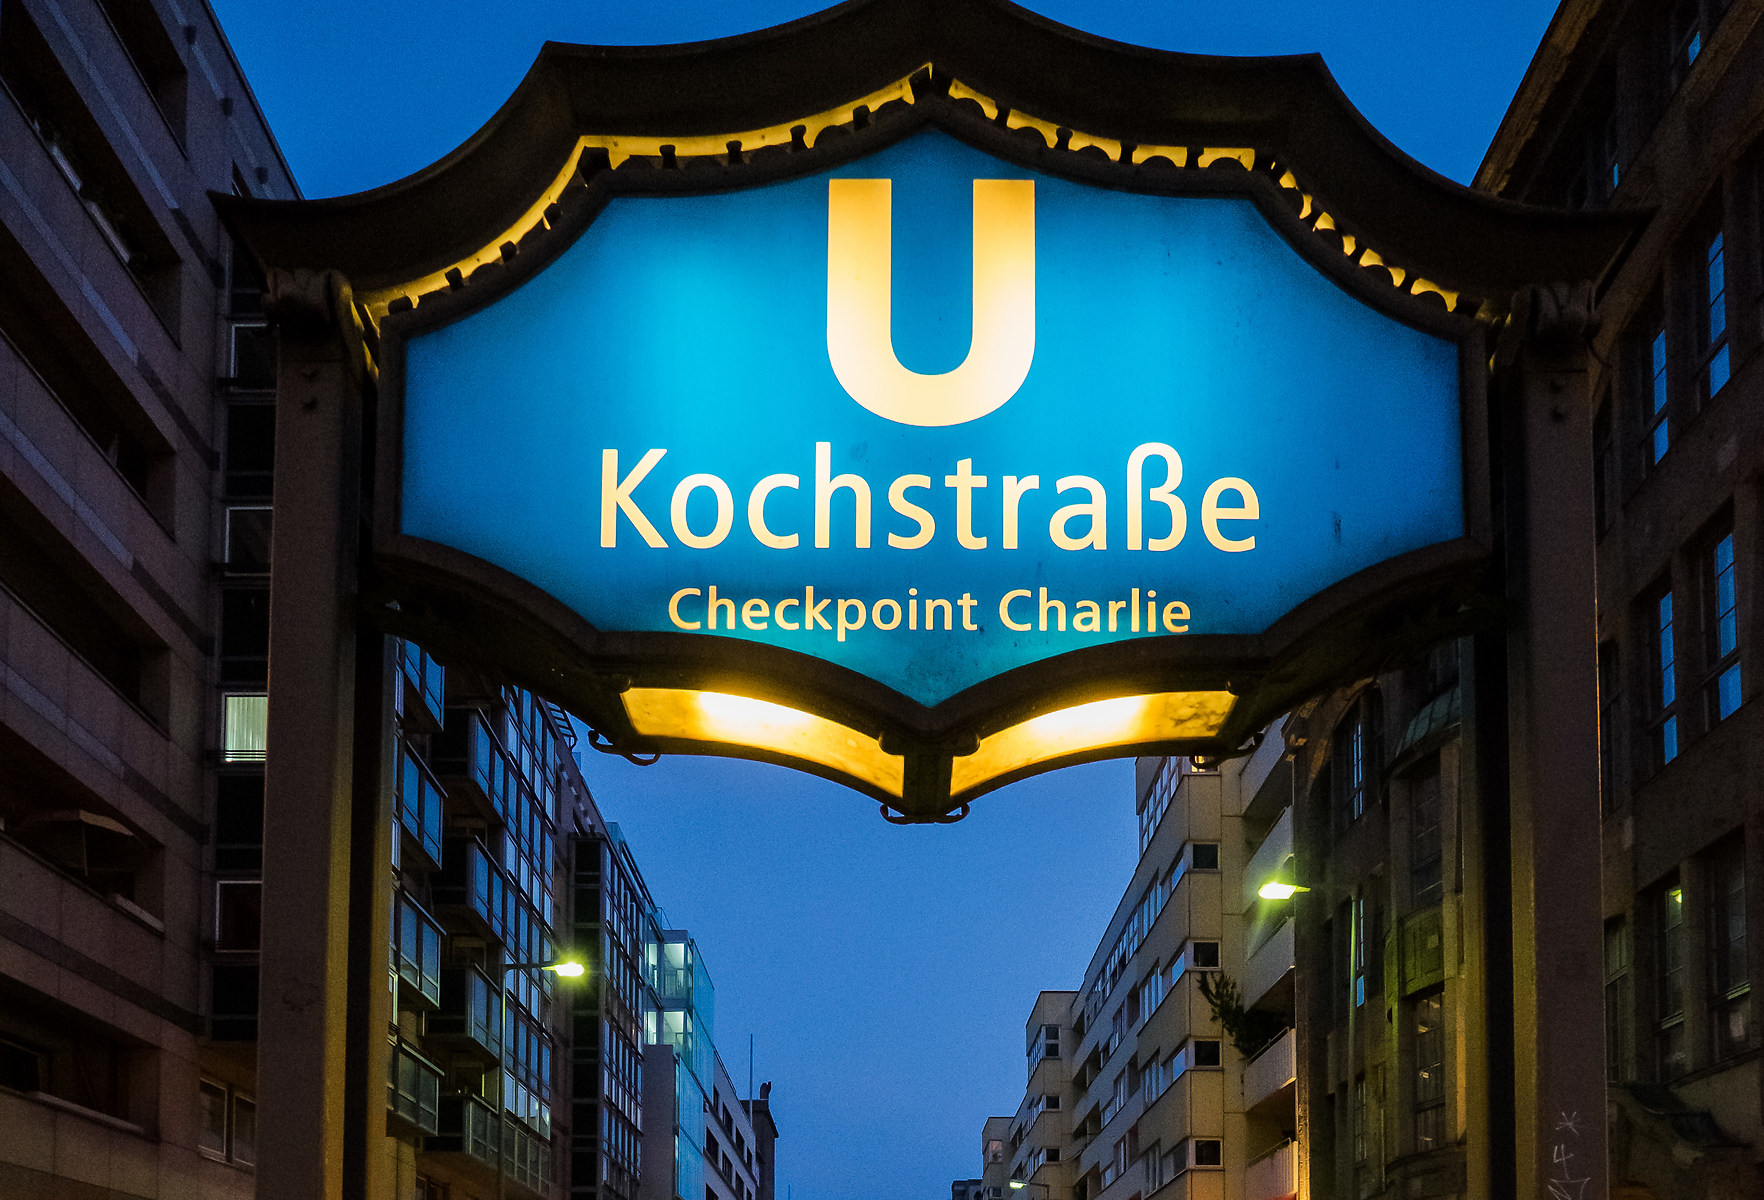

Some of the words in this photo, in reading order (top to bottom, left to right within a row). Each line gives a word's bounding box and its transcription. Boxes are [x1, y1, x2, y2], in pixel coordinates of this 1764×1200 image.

[826, 178, 1036, 428] U
[600, 441, 1260, 553] Kochstraße
[668, 585, 978, 642] Checkpoint
[998, 586, 1191, 634] Charlie
